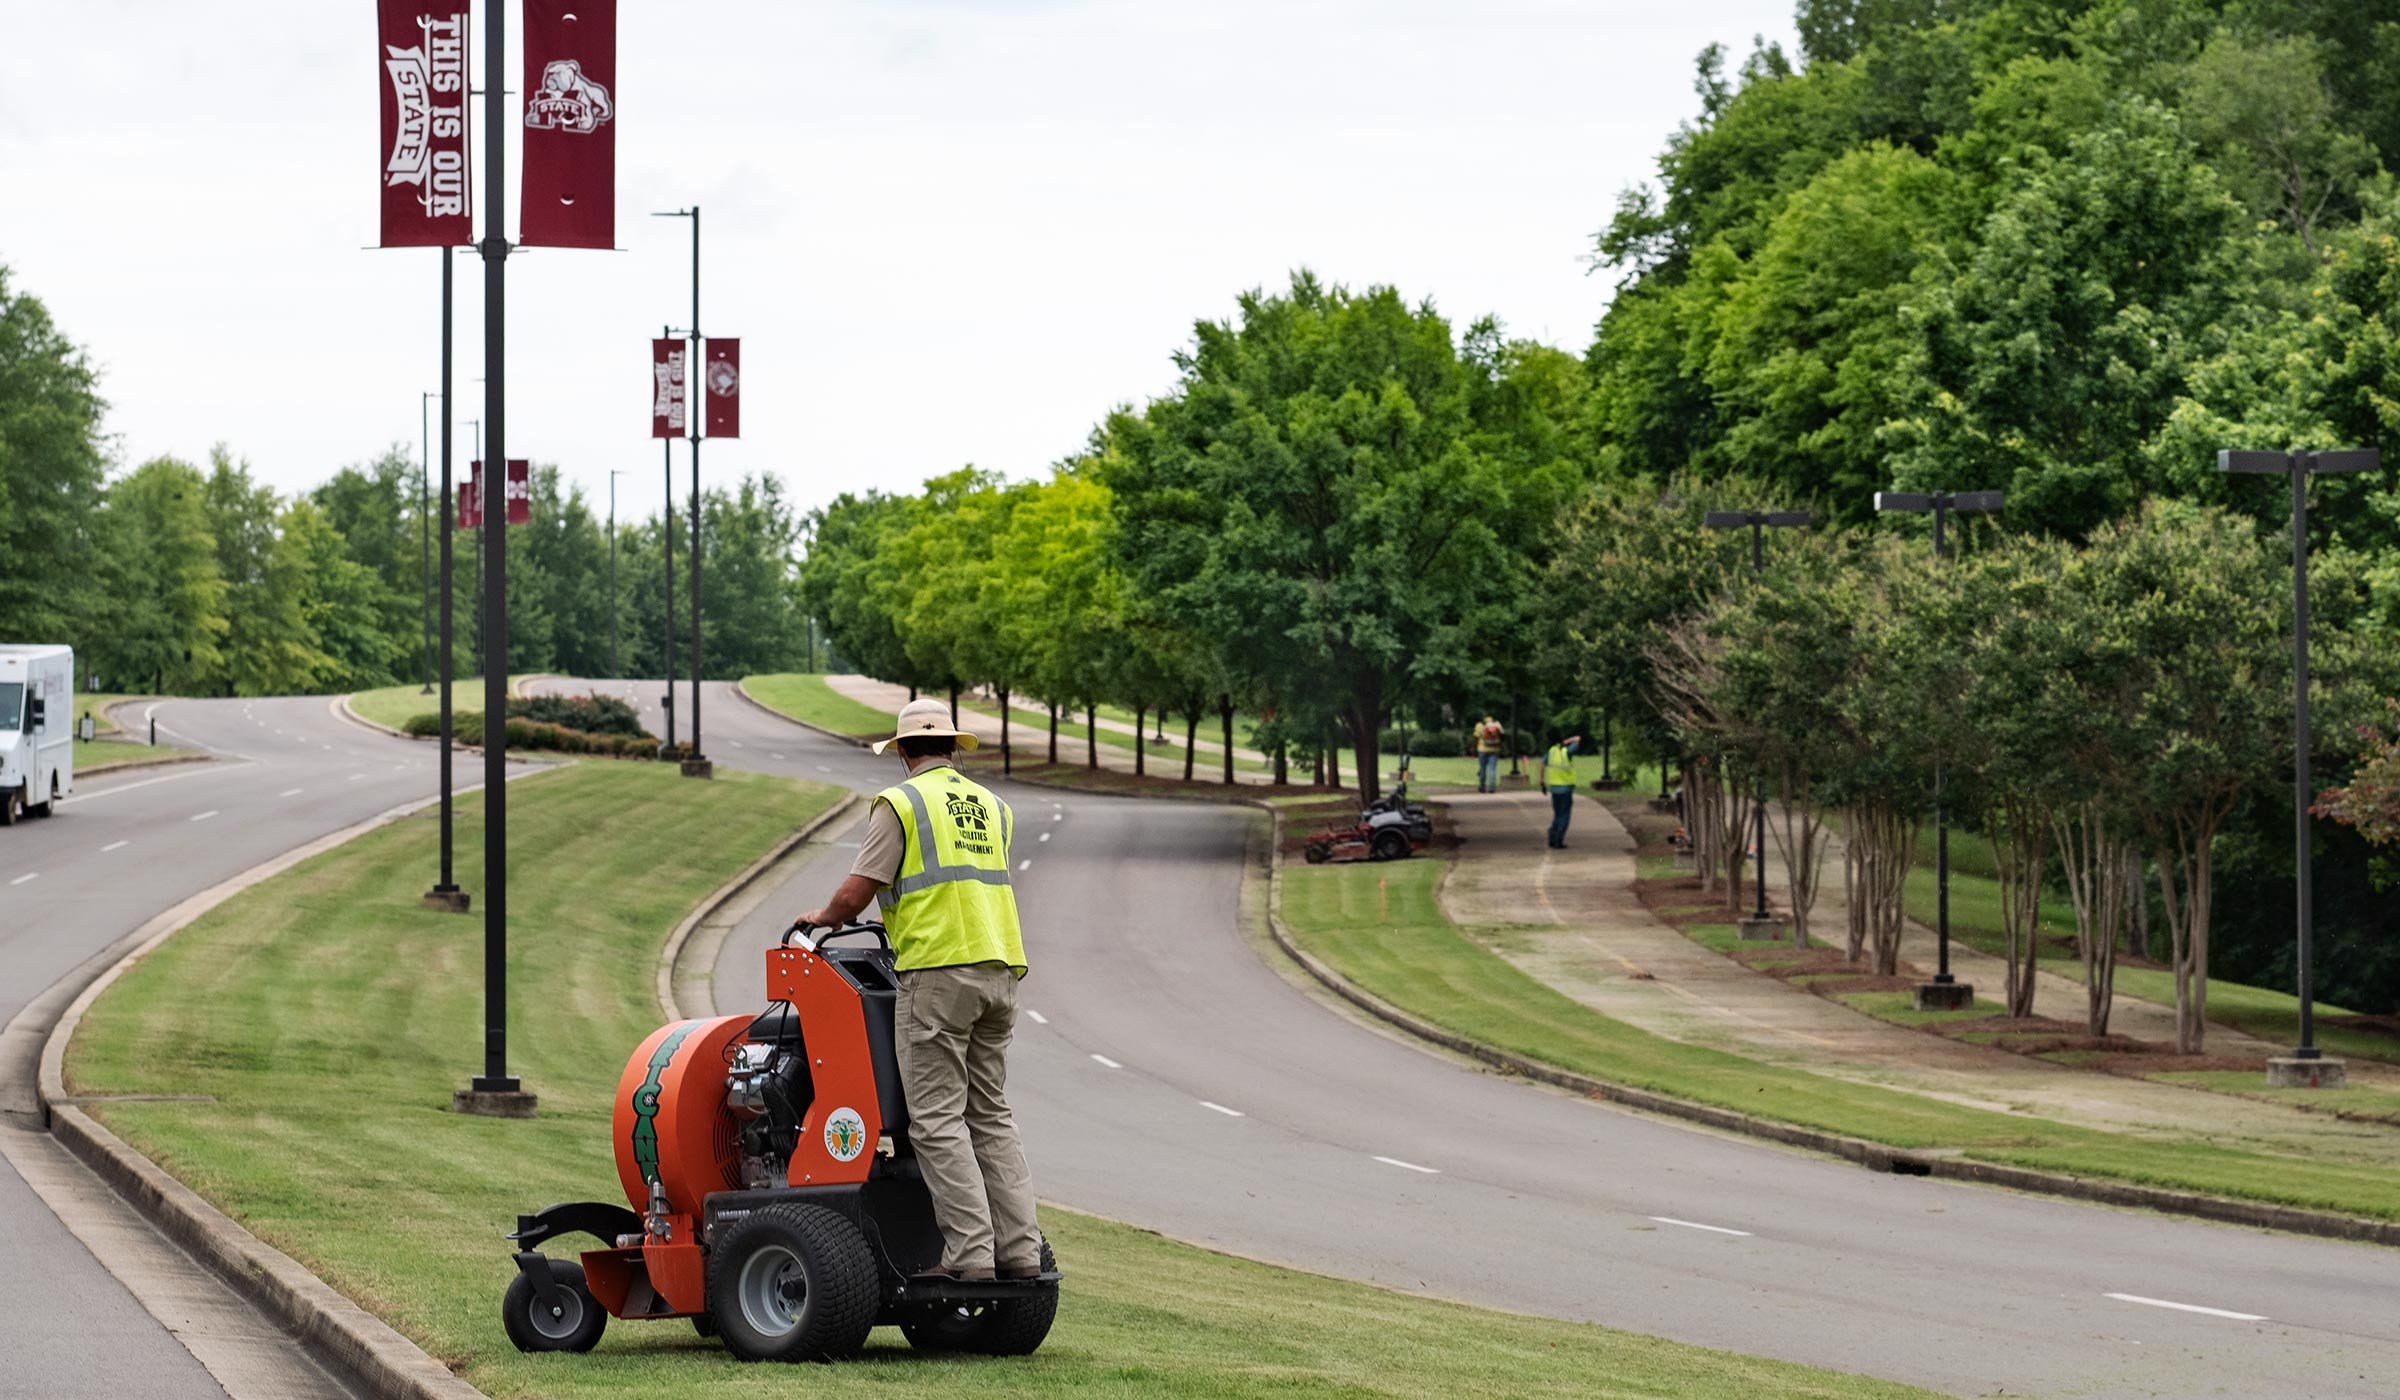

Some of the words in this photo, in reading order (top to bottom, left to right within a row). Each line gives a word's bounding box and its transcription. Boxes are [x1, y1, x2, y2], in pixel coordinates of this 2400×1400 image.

[432, 14, 461, 92] THIS
[398, 70, 423, 160] STATE
[540, 101, 579, 115] STATE
[432, 106, 461, 138] IS
[433, 151, 462, 217] OUR
[951, 802, 983, 818] STATE
[958, 829, 988, 841] CILITIES
[826, 1130, 838, 1156] BILLY
[850, 1129, 863, 1156] GOAT
